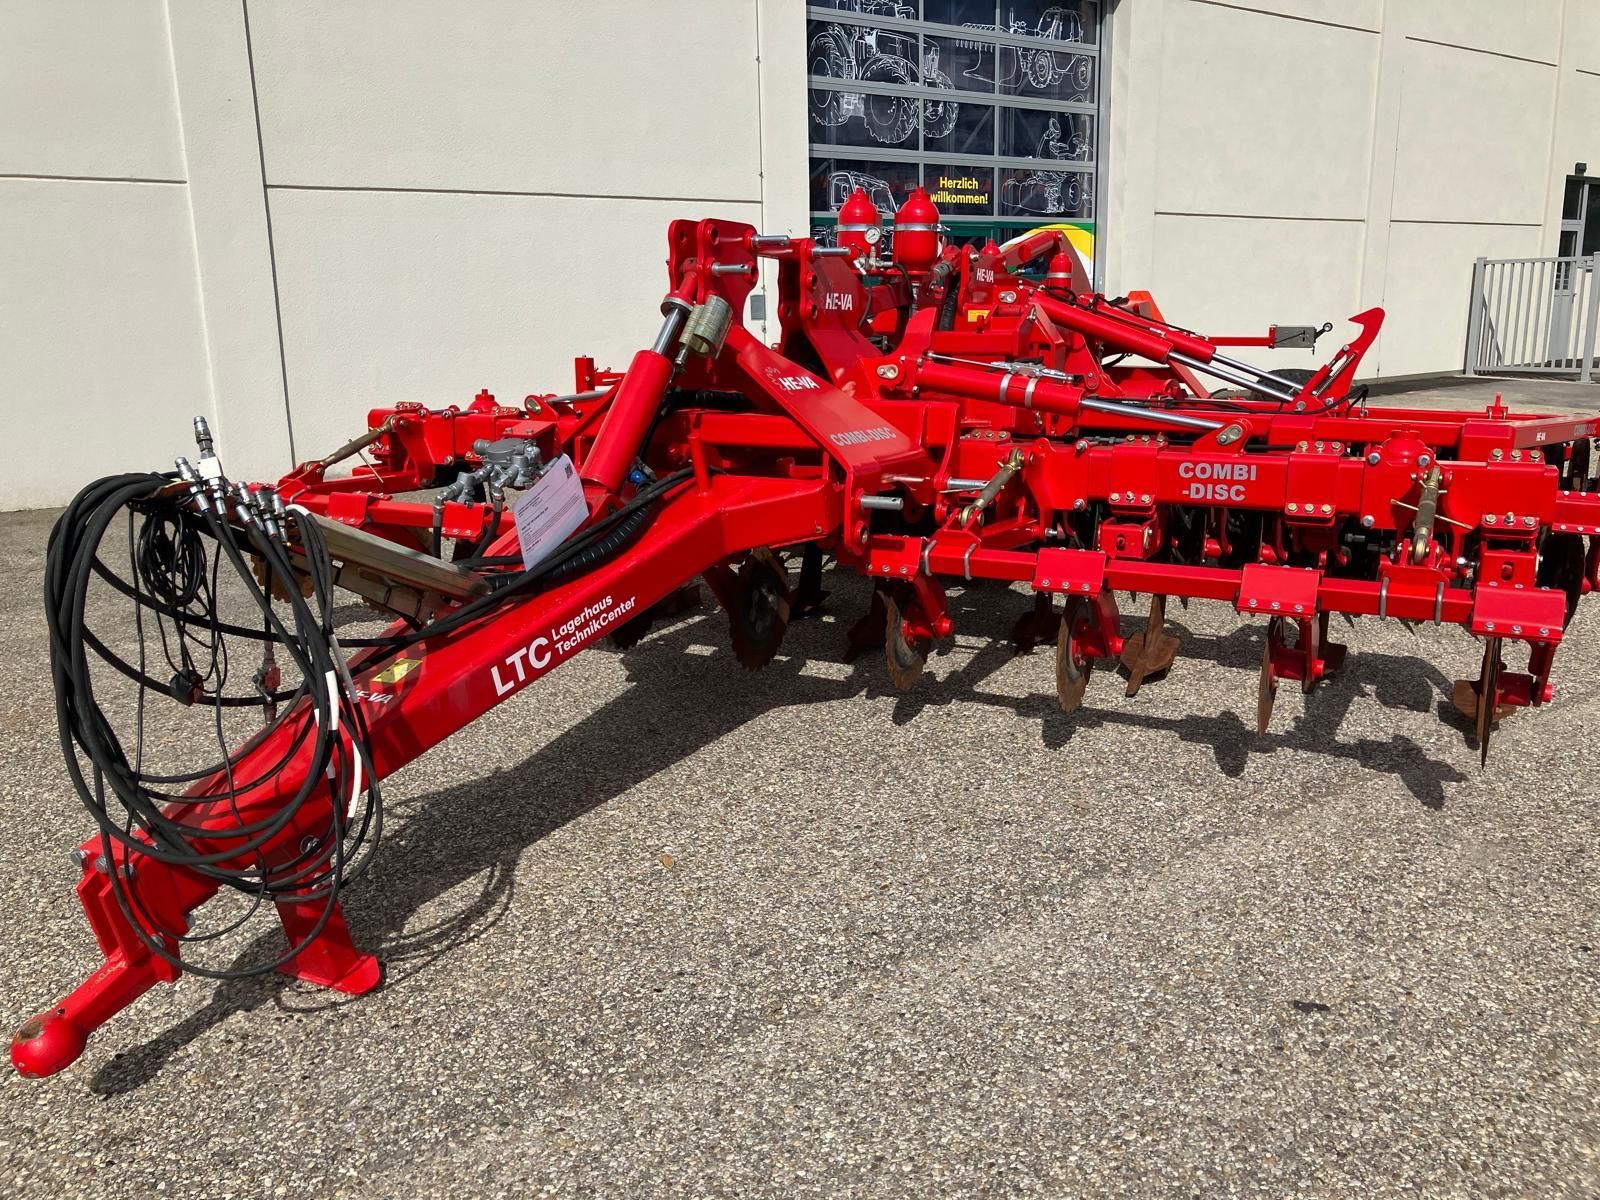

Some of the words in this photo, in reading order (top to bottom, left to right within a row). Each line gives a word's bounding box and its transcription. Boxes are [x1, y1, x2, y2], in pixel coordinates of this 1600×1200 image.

[940, 177, 978, 189] Herzlich
[930, 191, 988, 204] willkommen!
[976, 268, 994, 283] HE-VA
[825, 293, 853, 310] HE-VA
[780, 376, 820, 391] HE-VA
[829, 427, 896, 446] COMBI-DISC
[1178, 462, 1257, 480] COMBI
[1181, 482, 1246, 501] -DISC
[551, 595, 613, 641] Lagerhaus
[555, 596, 636, 655] TechnikCenter
[490, 636, 552, 696] LTC
